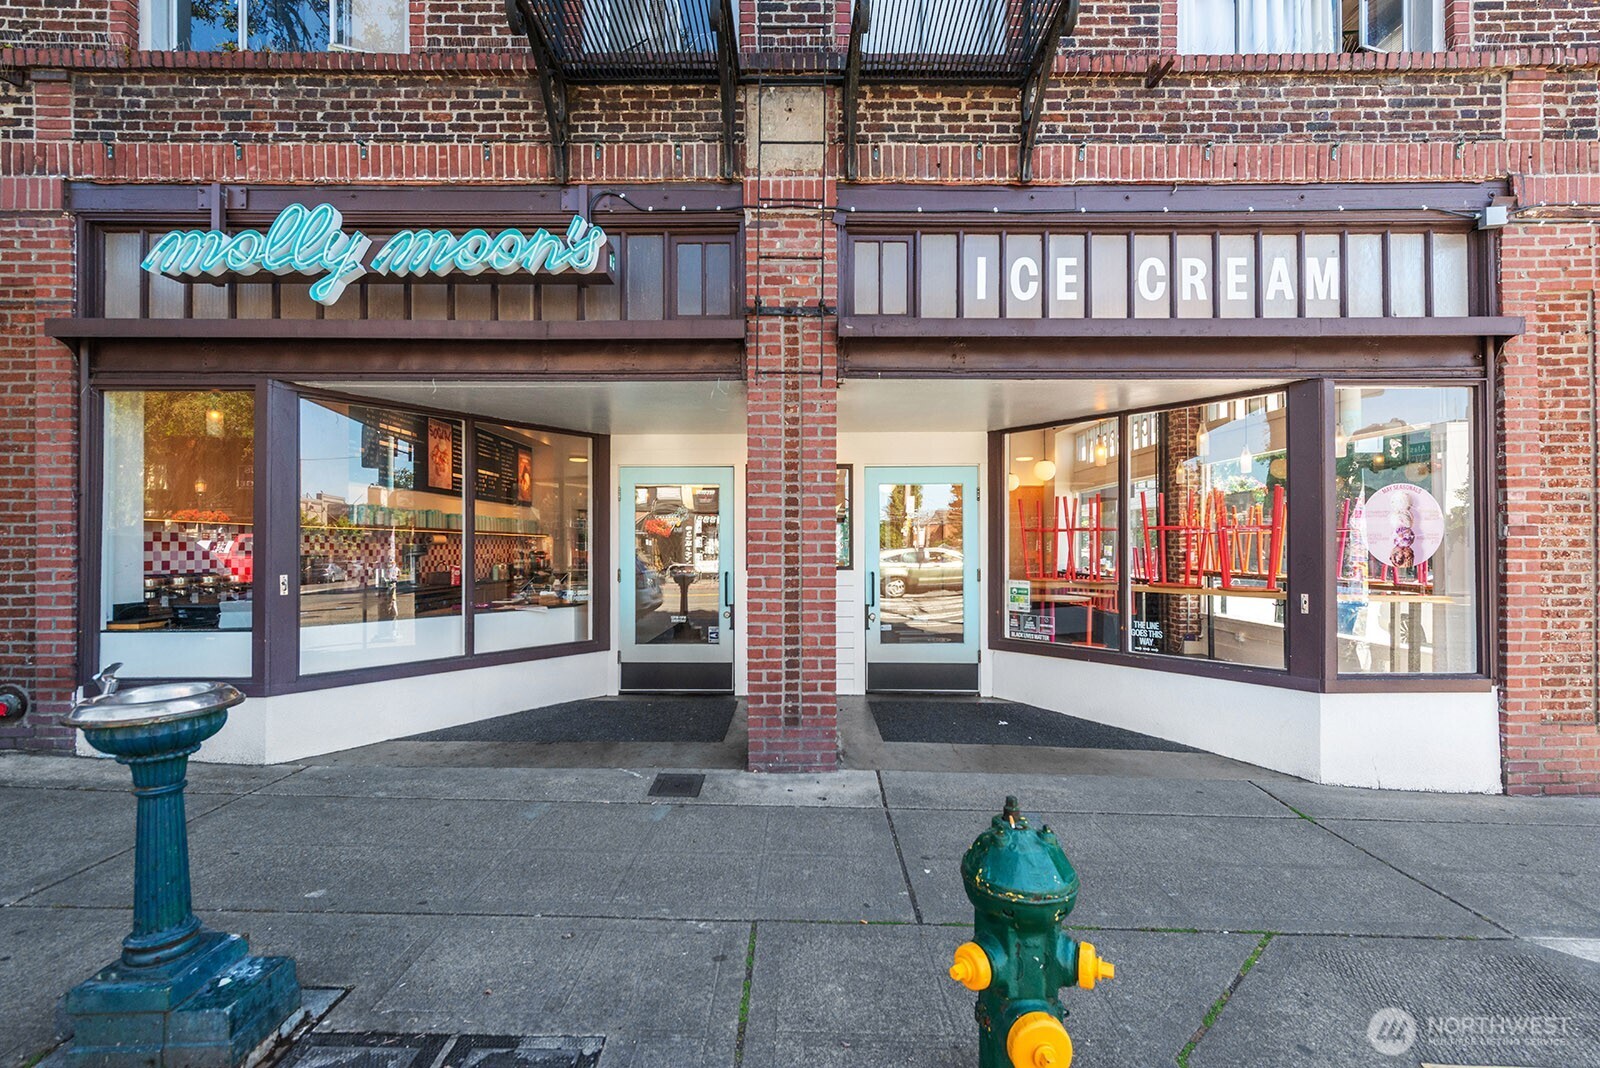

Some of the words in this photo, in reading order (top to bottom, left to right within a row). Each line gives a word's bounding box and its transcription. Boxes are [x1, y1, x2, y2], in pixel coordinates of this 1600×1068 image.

[141, 202, 372, 306] molly
[370, 215, 607, 277] moon's
[976, 256, 1077, 301] ICE
[1137, 255, 1339, 301] CREAM
[1133, 620, 1145, 629] THE
[1146, 621, 1160, 630] LINE
[1130, 629, 1148, 637] GOES
[1148, 630, 1163, 639] THIS
[1139, 637, 1154, 646] WAY
